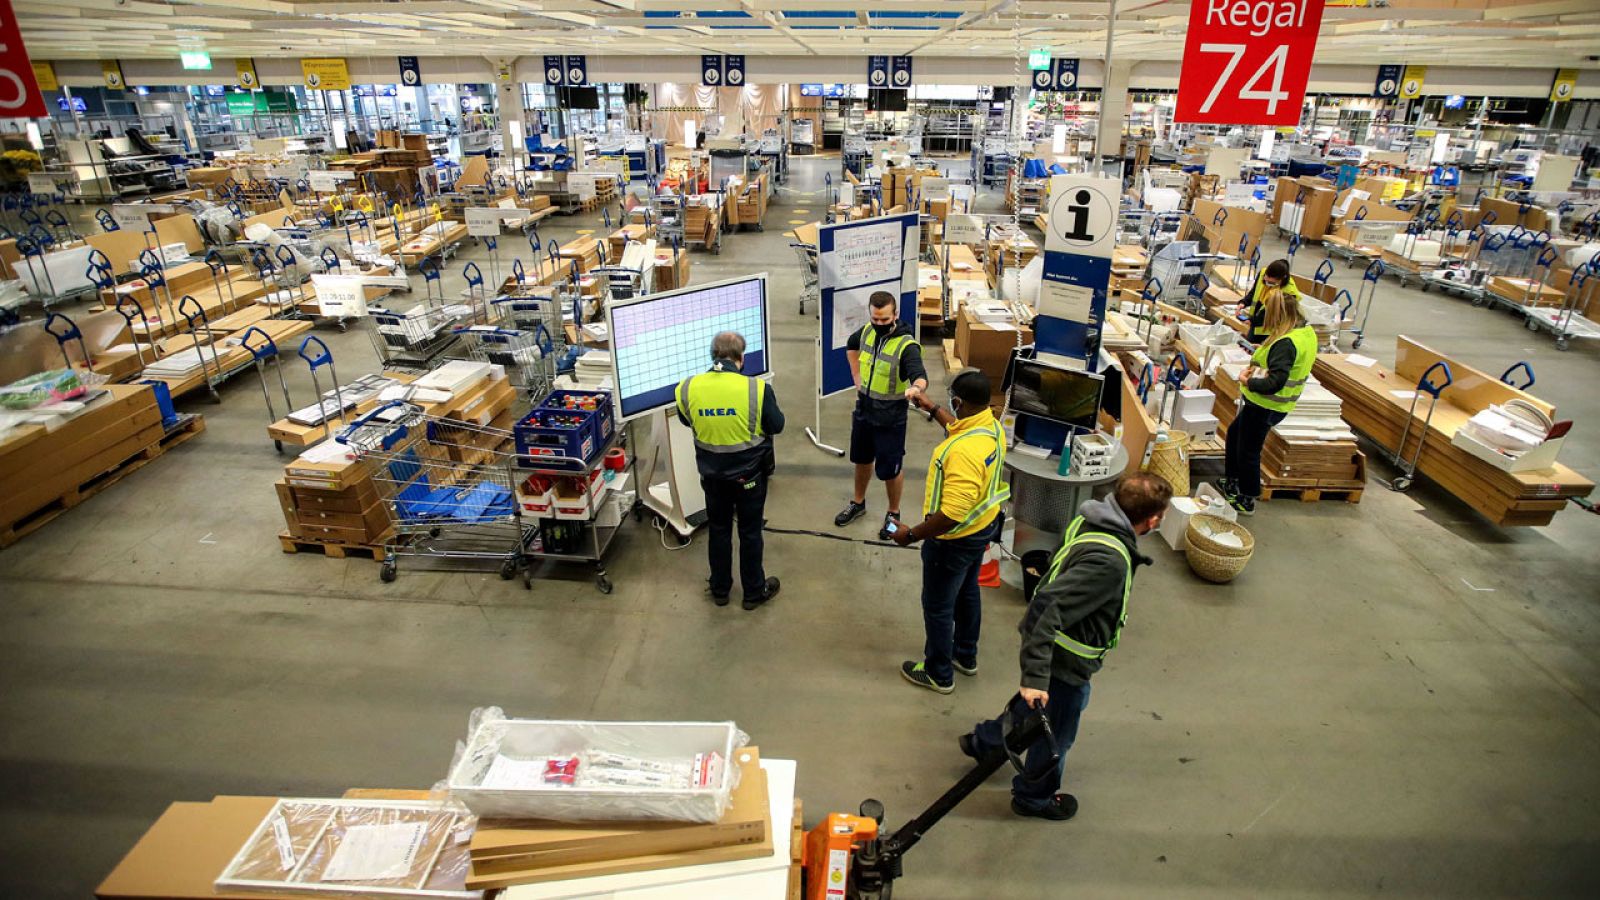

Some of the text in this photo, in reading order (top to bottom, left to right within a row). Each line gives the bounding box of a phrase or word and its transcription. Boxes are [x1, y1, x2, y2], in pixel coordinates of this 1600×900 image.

[1206, 0, 1308, 37] Regal
[1198, 43, 1290, 116] 74
[698, 408, 737, 416] IKEA
